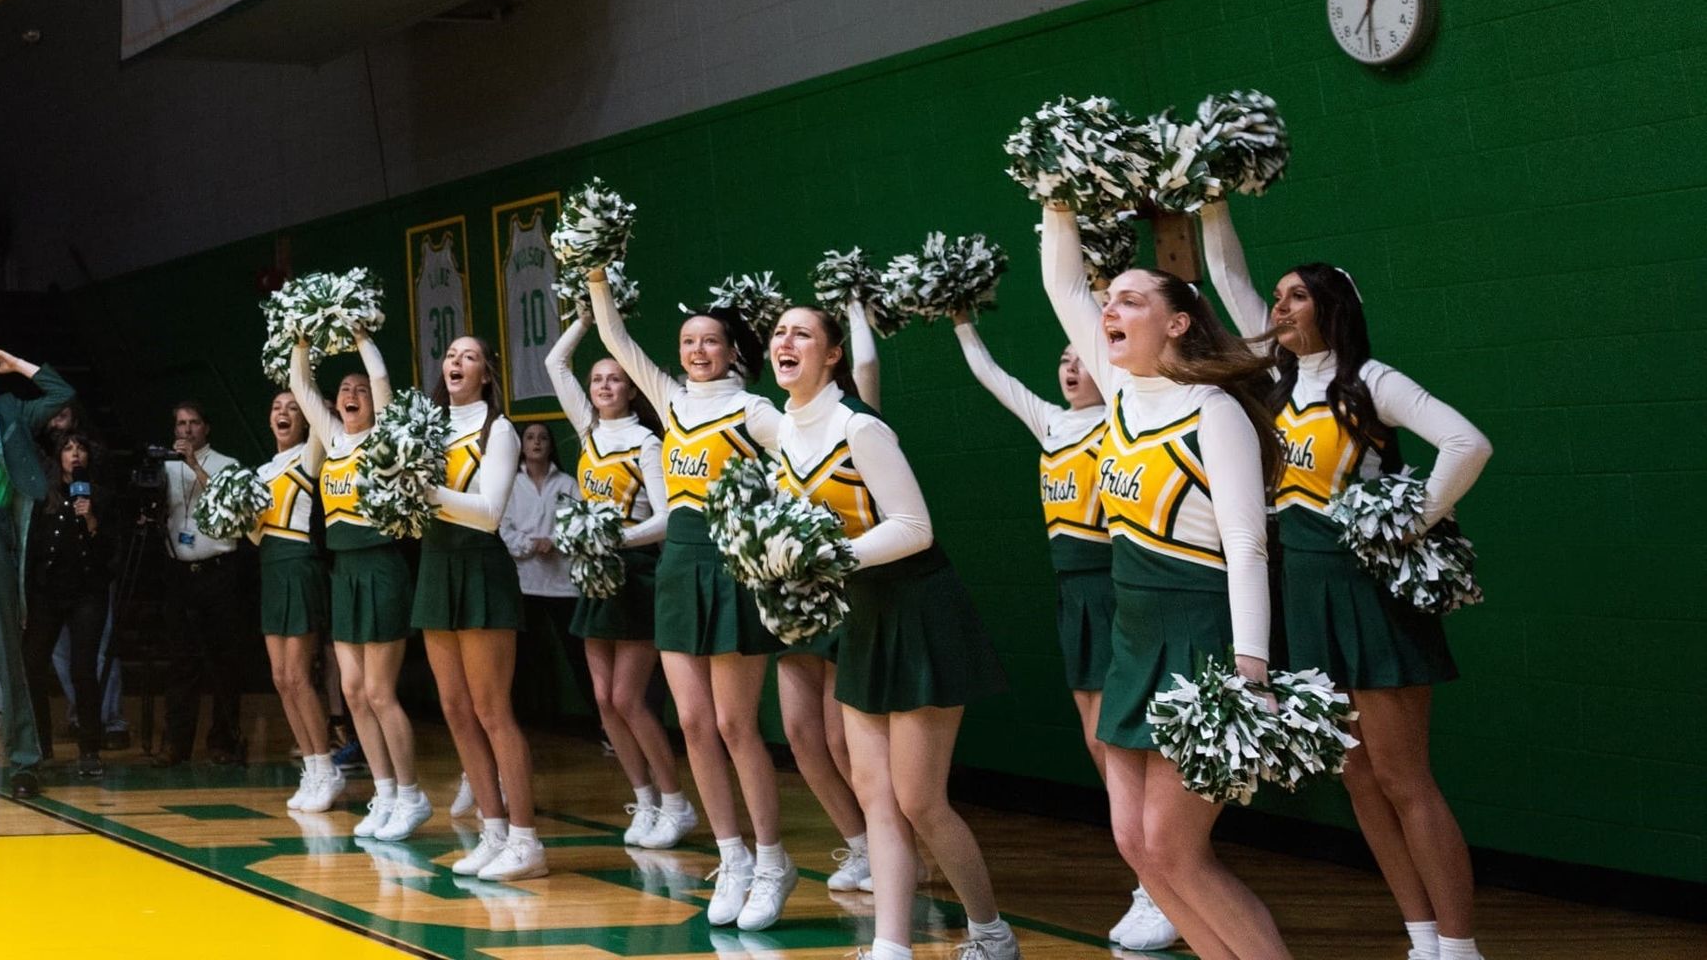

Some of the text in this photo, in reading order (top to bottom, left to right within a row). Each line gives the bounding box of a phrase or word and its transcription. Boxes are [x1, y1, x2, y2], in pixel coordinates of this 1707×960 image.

[429, 305, 455, 360] 30
[520, 288, 547, 348] 10
[668, 447, 709, 478] Irish
[1098, 456, 1145, 502] Irish
[323, 472, 352, 496] Irish
[583, 469, 614, 498] Irish
[1041, 470, 1077, 504] Irish
